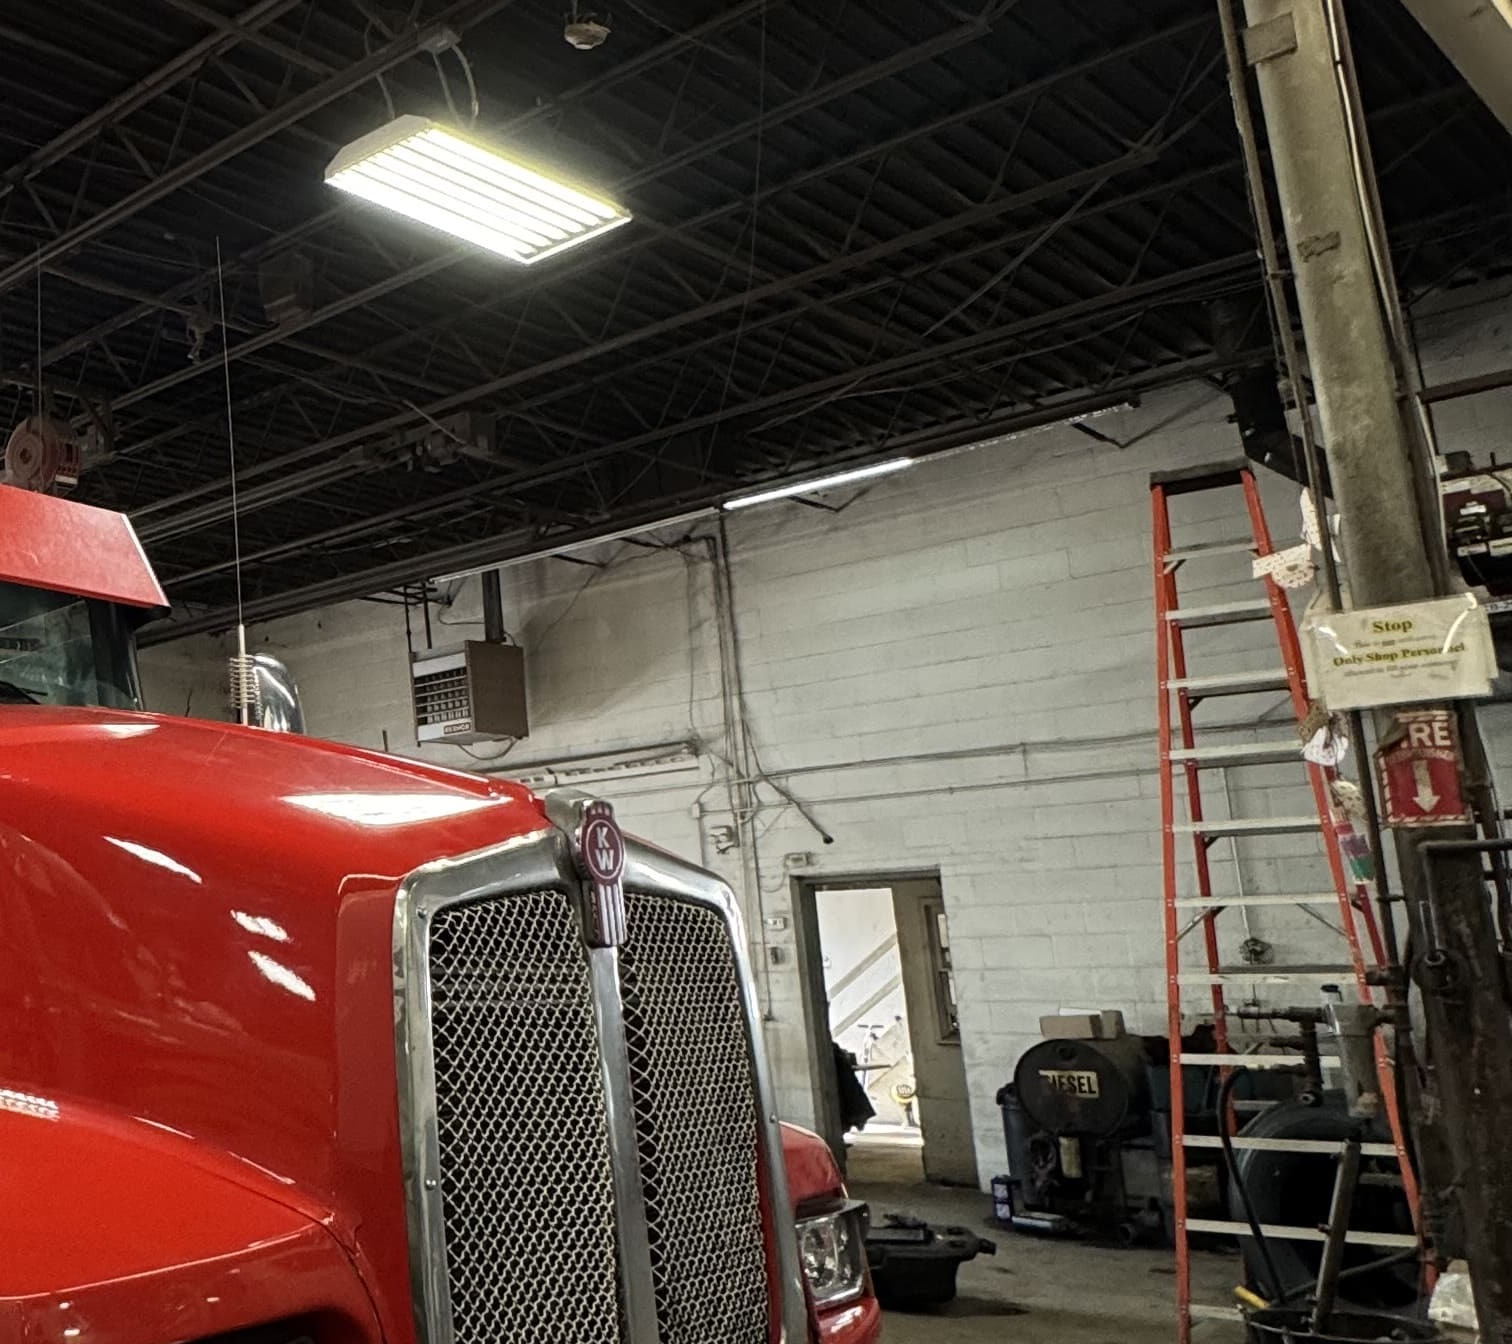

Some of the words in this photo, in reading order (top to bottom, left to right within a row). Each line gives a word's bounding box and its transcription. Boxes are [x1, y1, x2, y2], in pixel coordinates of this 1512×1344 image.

[1372, 619, 1413, 633] Stop
[1333, 655, 1363, 667] Only
[1366, 651, 1398, 662] Shop
[1047, 1074, 1097, 1094] IESEL
